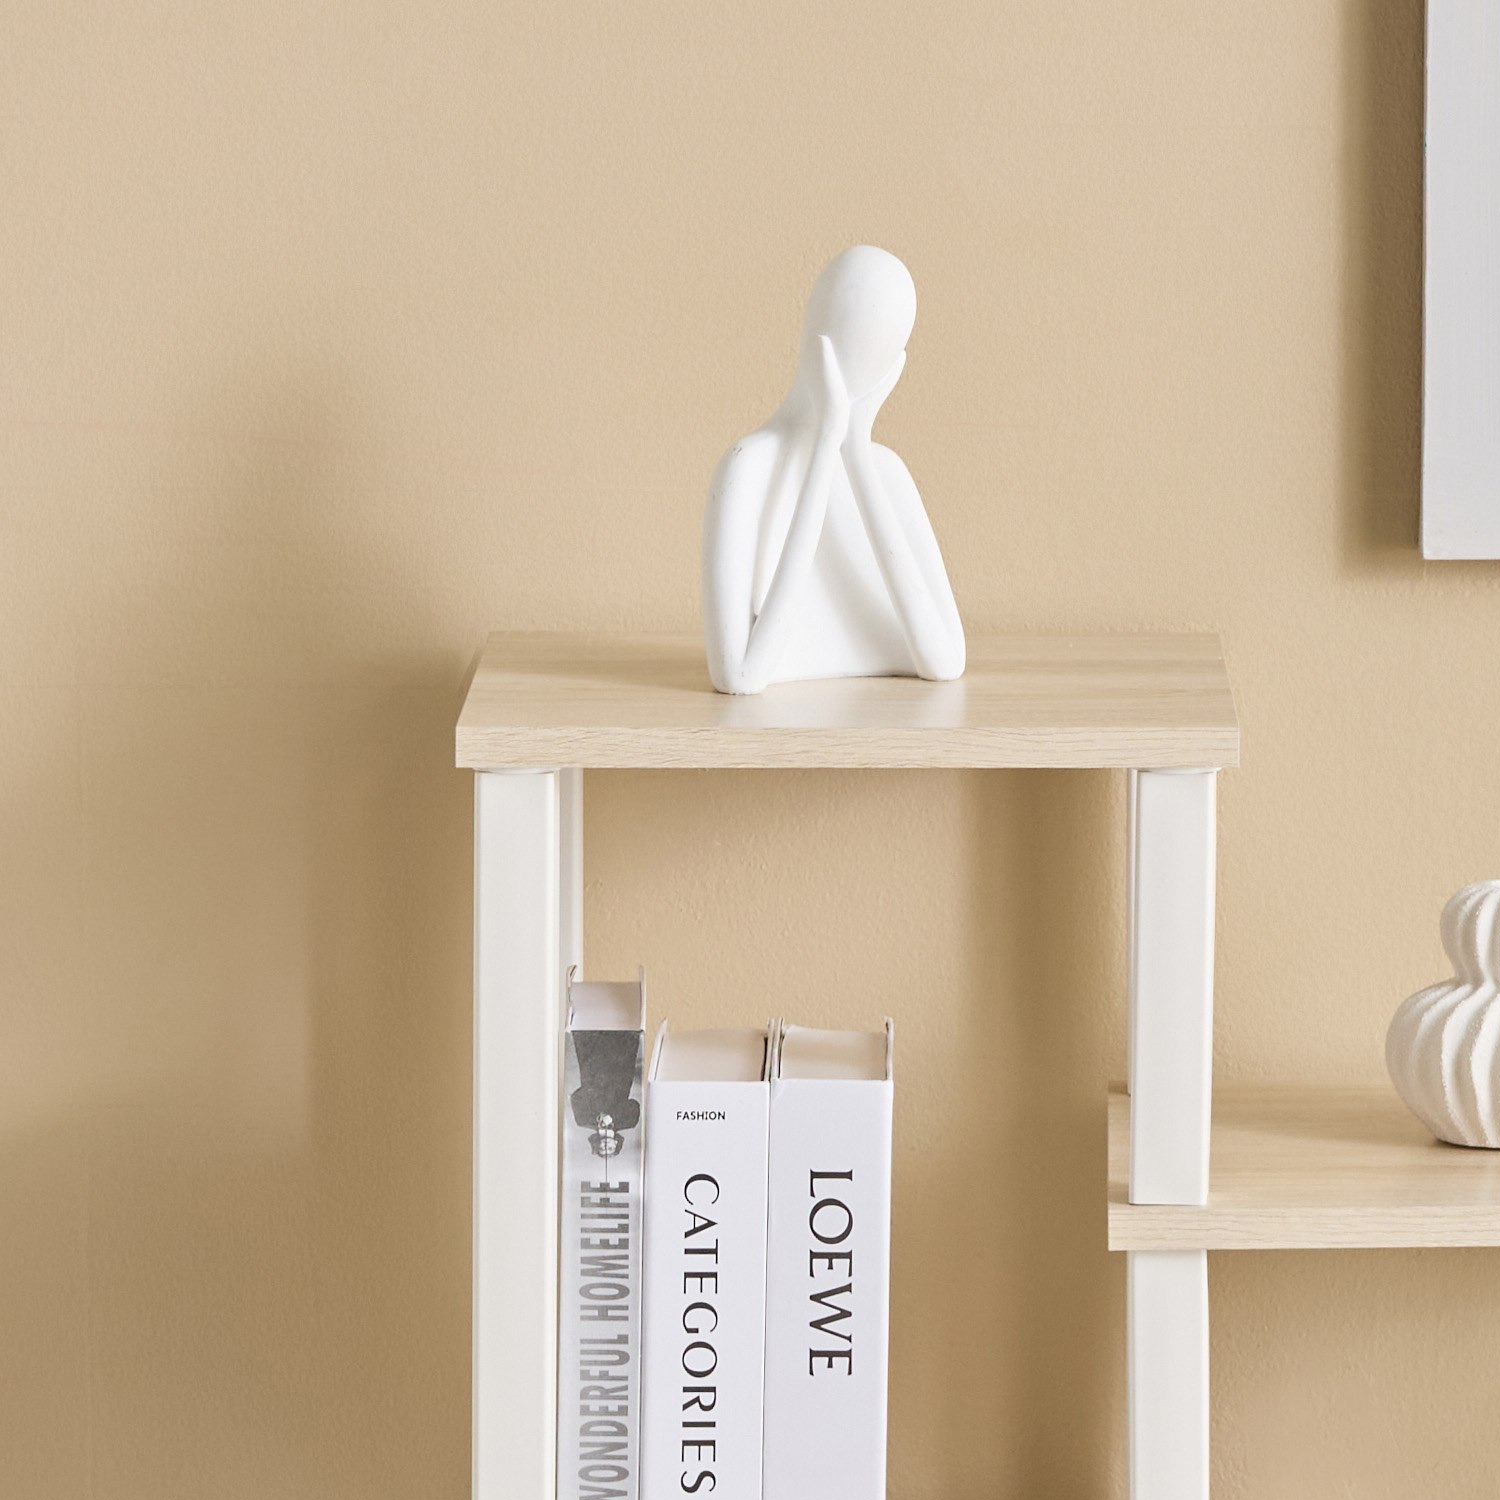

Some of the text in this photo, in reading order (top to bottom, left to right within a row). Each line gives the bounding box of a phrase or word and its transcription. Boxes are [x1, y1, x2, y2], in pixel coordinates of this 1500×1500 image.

[676, 1111, 726, 1120] FASHION
[579, 1181, 630, 1321] HOMELIFE
[680, 1173, 720, 1493] CATEGORIES
[808, 1168, 854, 1377] LOEWE
